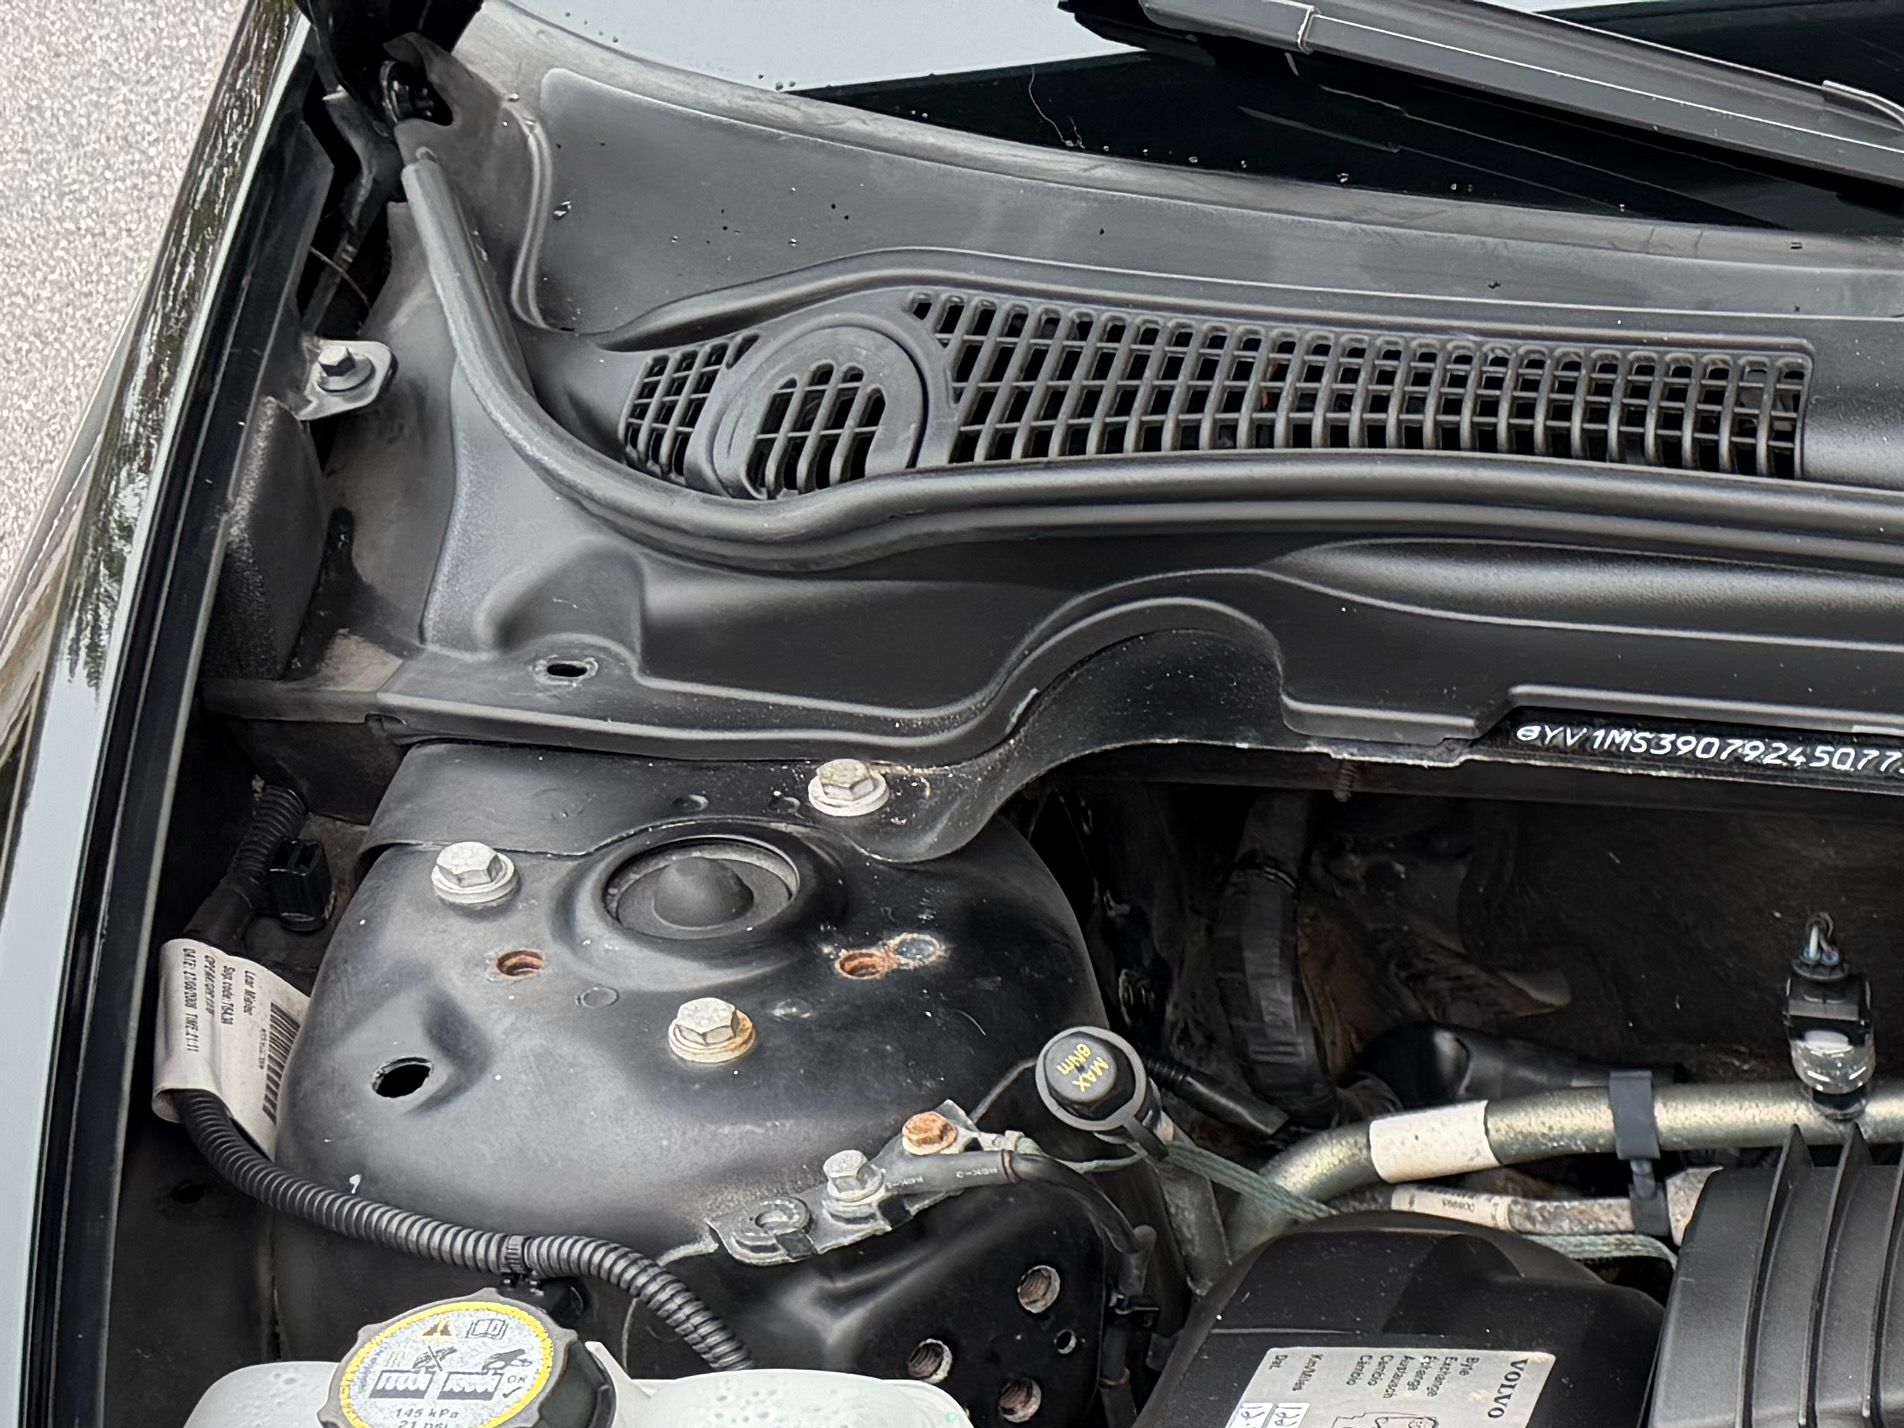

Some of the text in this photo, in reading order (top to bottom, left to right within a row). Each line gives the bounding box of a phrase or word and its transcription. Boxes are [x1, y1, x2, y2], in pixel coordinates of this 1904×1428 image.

[1072, 1056, 1108, 1092] MAX
[1456, 1356, 1479, 1375] Byte
[506, 1375, 527, 1383] OK
[1424, 1356, 1458, 1397] Exchange
[1484, 1358, 1529, 1419] VOLVO
[394, 1408, 459, 1418] 145 kPa
[398, 1420, 412, 1428] 21
